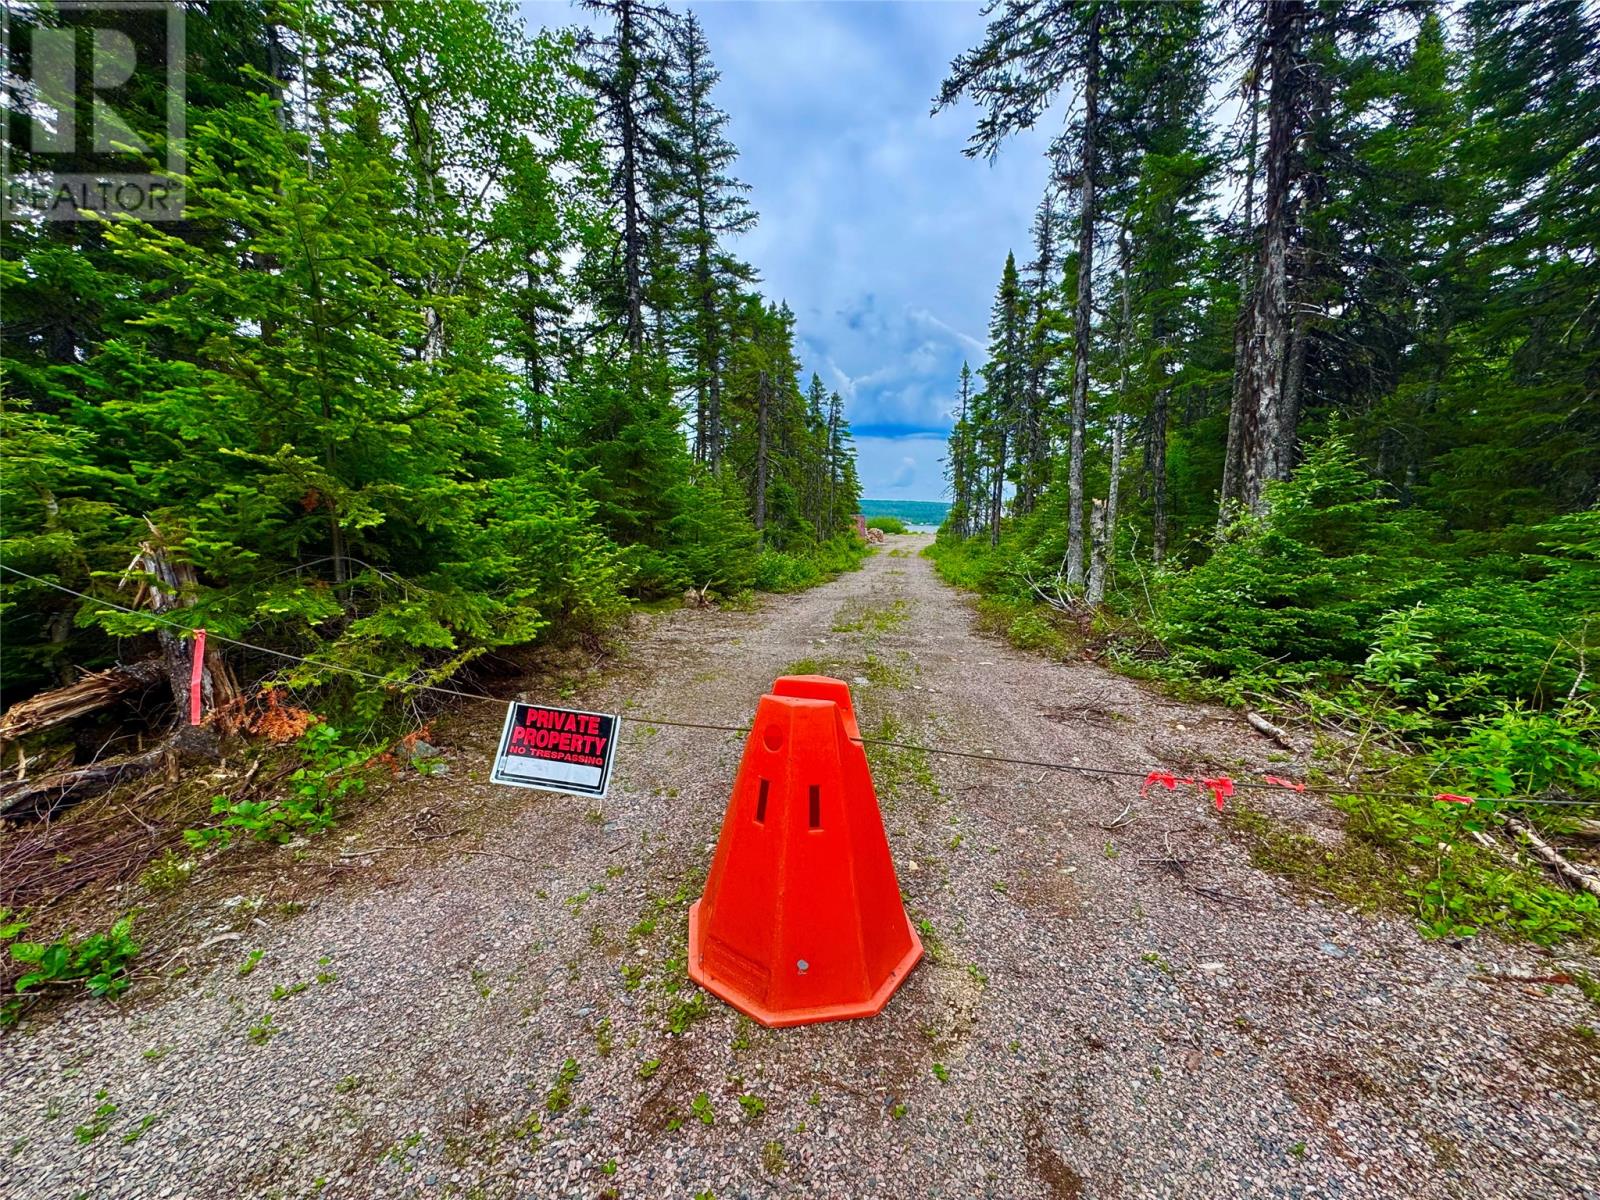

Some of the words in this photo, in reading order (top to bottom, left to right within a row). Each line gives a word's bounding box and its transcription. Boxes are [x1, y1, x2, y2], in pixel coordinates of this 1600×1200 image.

[526, 708, 601, 734] PRIVATE
[511, 726, 607, 755] PROPERTY
[509, 745, 526, 755] NO
[530, 748, 603, 766] TRESPASSING
